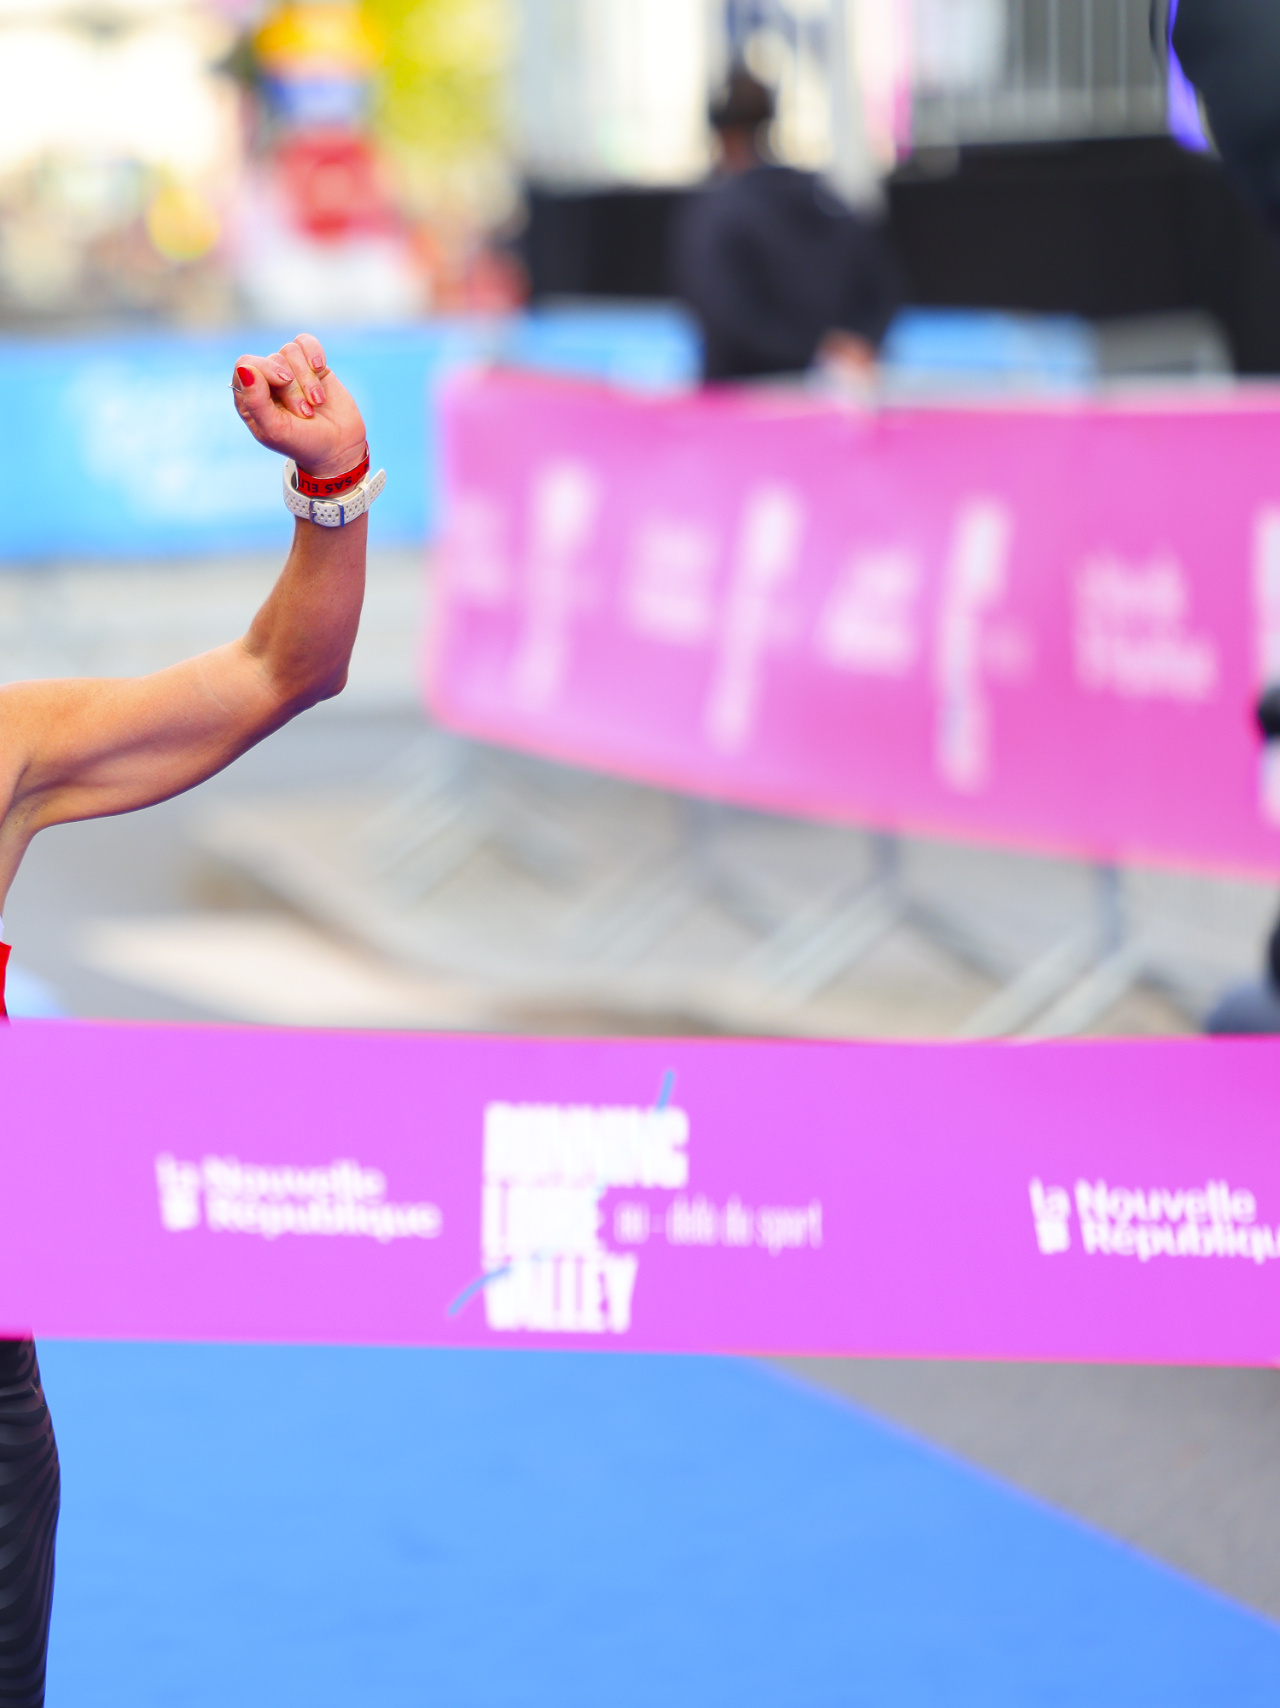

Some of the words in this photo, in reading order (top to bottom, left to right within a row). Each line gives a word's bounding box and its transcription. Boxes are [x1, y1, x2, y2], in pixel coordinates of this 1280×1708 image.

[325, 476, 352, 494] SAS
[199, 1153, 388, 1202] Nouvelle
[1073, 1178, 1256, 1224] Nouvelle
[204, 1196, 445, 1245] République
[1079, 1220, 1280, 1265] Républiqu
[483, 1251, 639, 1334] VALLEY
